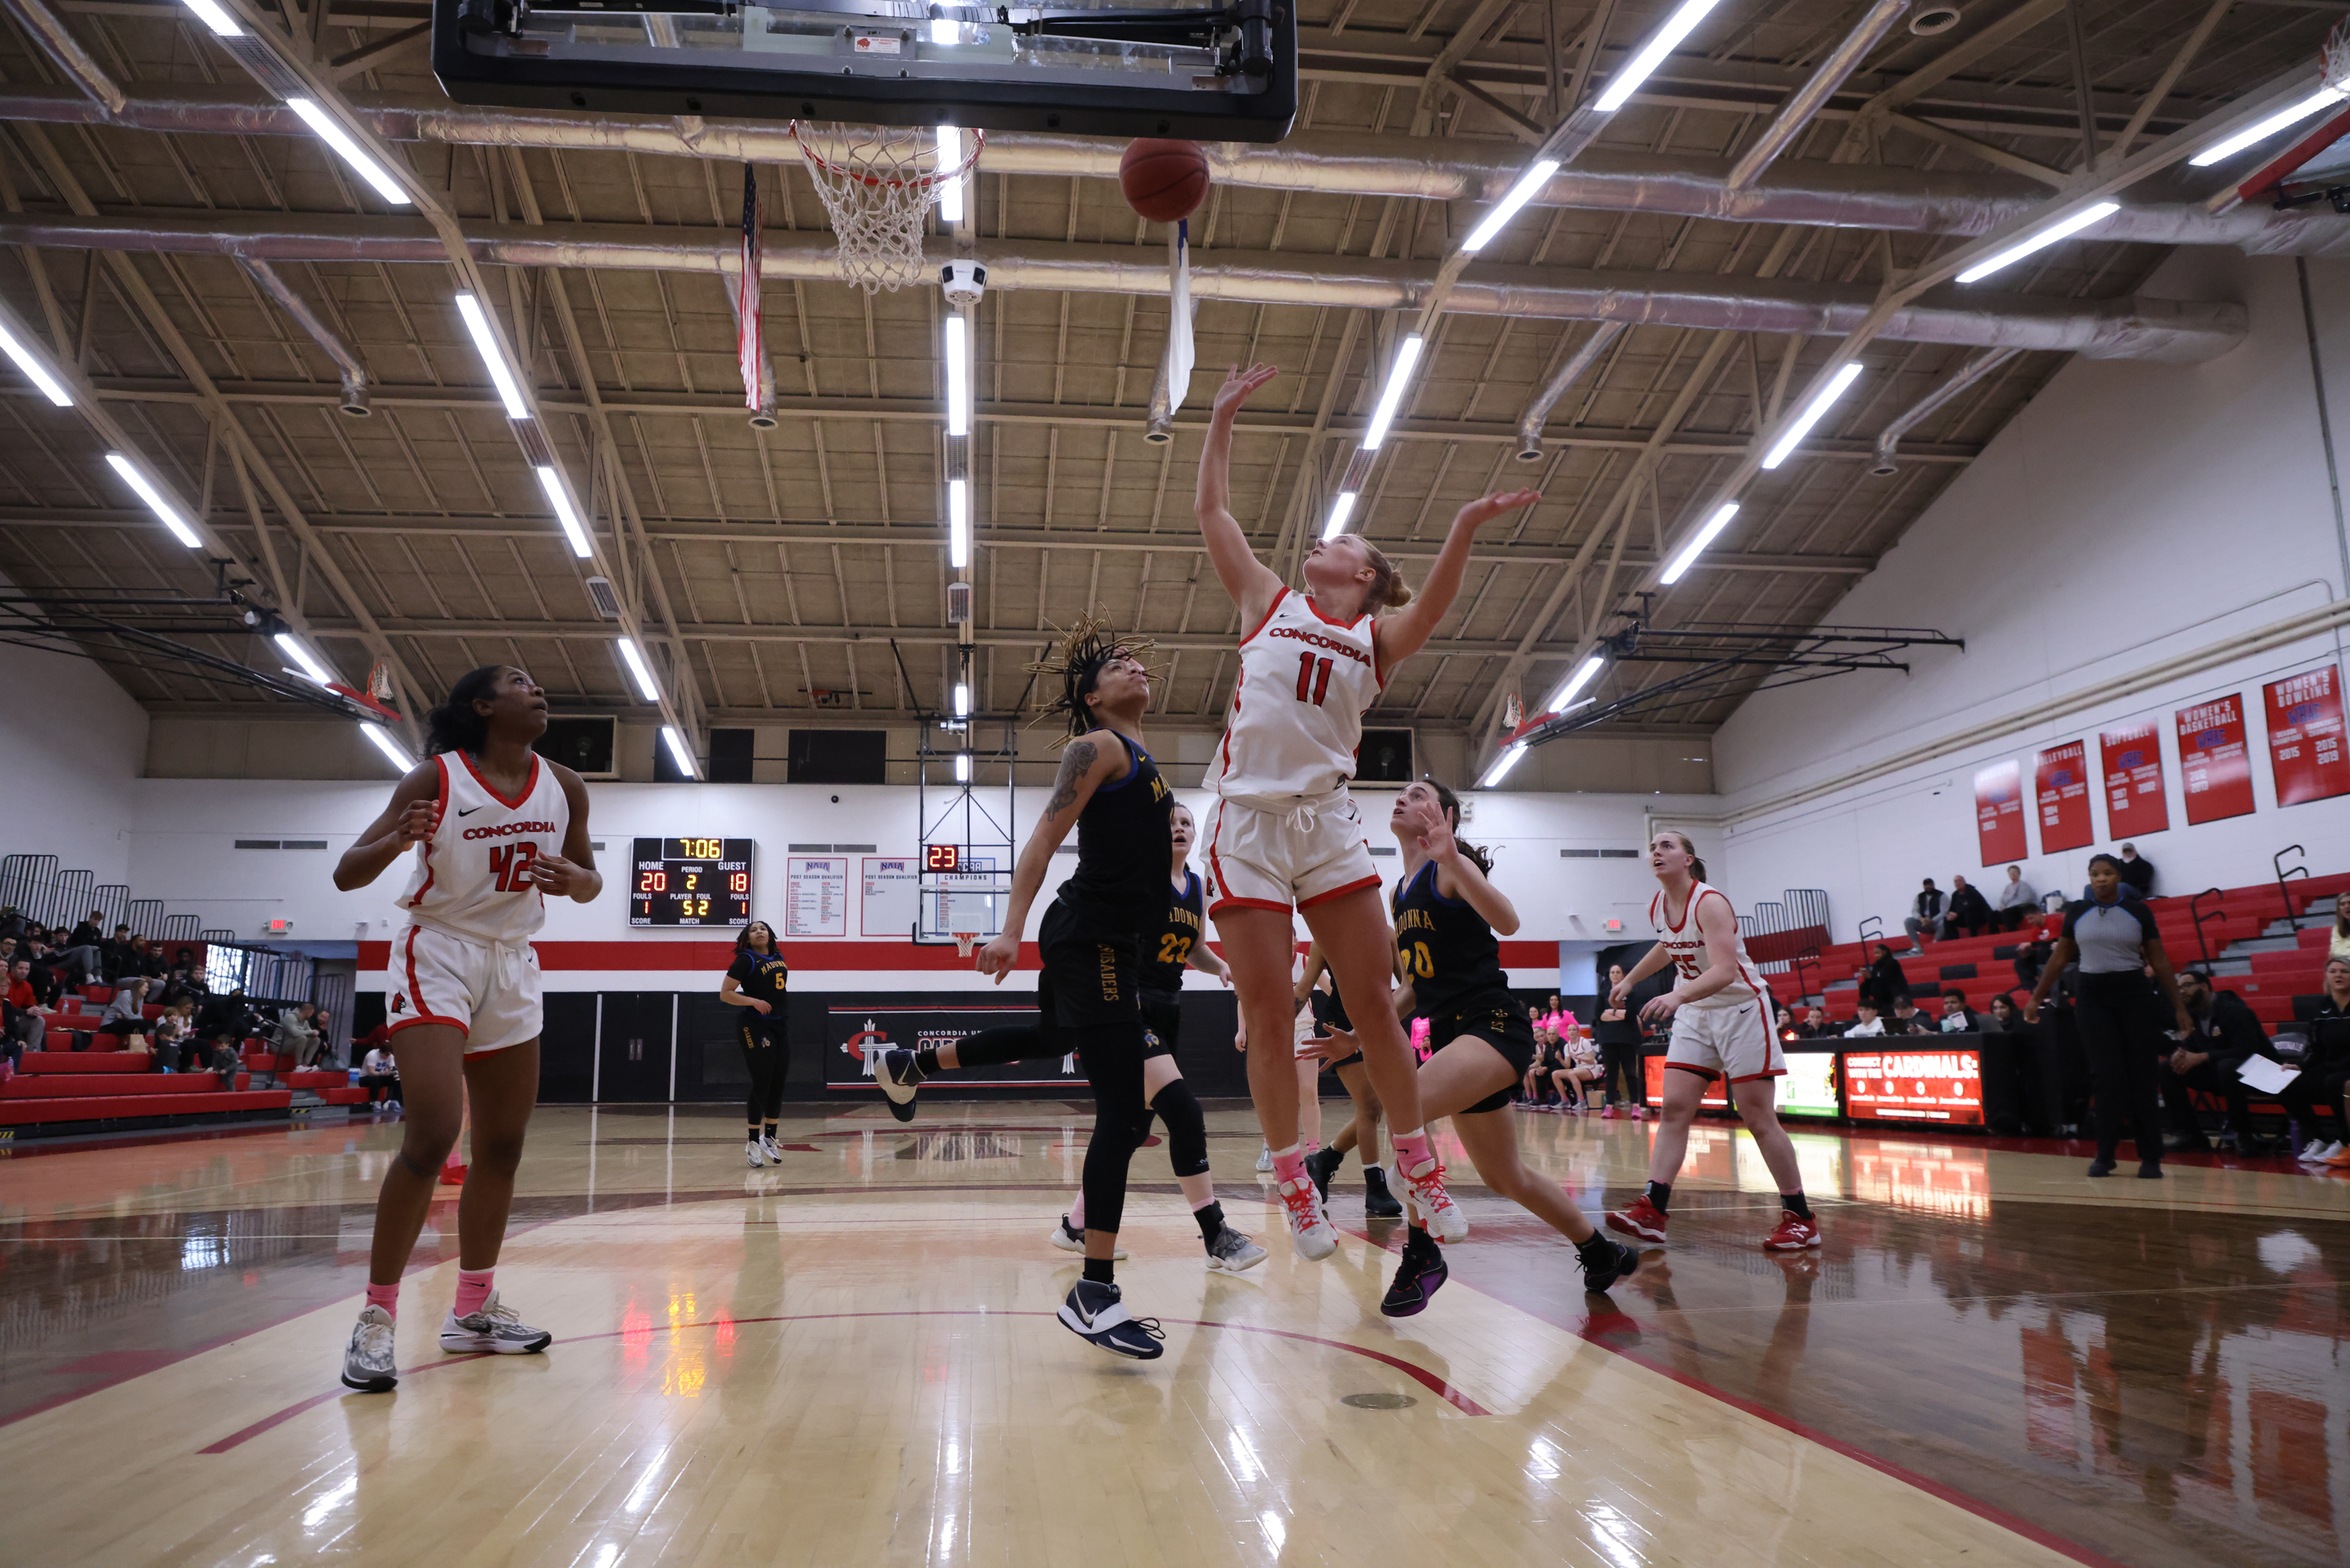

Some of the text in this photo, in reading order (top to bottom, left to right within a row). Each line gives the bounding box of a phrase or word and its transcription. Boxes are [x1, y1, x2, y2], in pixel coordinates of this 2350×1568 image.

[1269, 628, 1371, 667] CONCORDIA
[1297, 651, 1334, 708] 11
[2275, 671, 2329, 696] WOMEN'S
[2278, 683, 2330, 707] BOWLING
[2184, 701, 2231, 722] WOMEN'S
[2180, 711, 2237, 735] BASKETBALL
[463, 822, 556, 840] CONCORDIA
[680, 839, 720, 858] 7:06
[930, 847, 955, 868] 23
[490, 842, 538, 892] 42
[638, 861, 746, 871] HOME GUEST
[806, 862, 830, 871] NAIA
[881, 862, 904, 871] NAIA
[641, 873, 665, 891] 20
[686, 875, 697, 890] 2
[730, 873, 747, 892] 18
[644, 901, 649, 914] 1
[741, 901, 746, 914] 1
[1400, 941, 1435, 987] 20
[775, 972, 785, 990] 5
